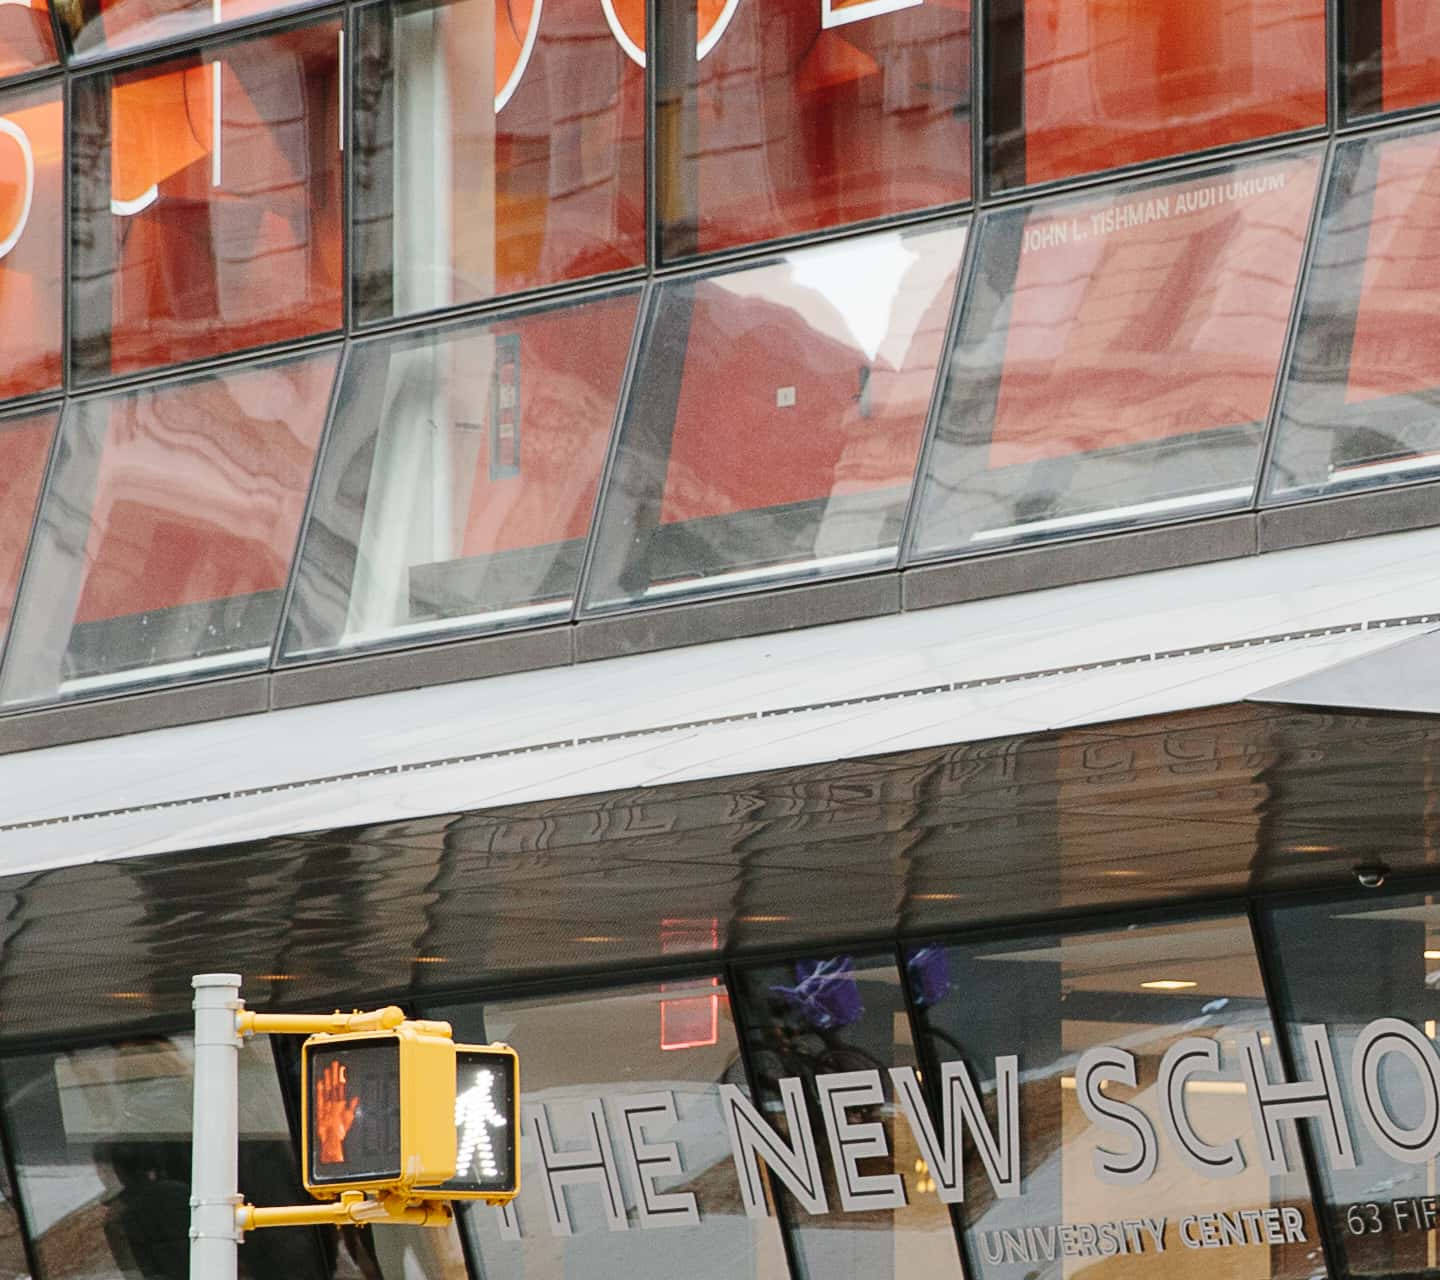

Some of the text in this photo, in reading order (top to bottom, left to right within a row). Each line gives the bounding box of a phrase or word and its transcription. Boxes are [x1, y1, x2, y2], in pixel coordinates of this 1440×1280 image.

[1022, 227, 1067, 253] JOHN
[1091, 197, 1169, 235] TISHMAN
[496, 1091, 702, 1242] HE
[719, 1055, 1021, 1218] NEW
[978, 1218, 1170, 1267] UNIVERSITY
[1179, 1207, 1307, 1251] CENTER
[1346, 1201, 1382, 1238] 63
